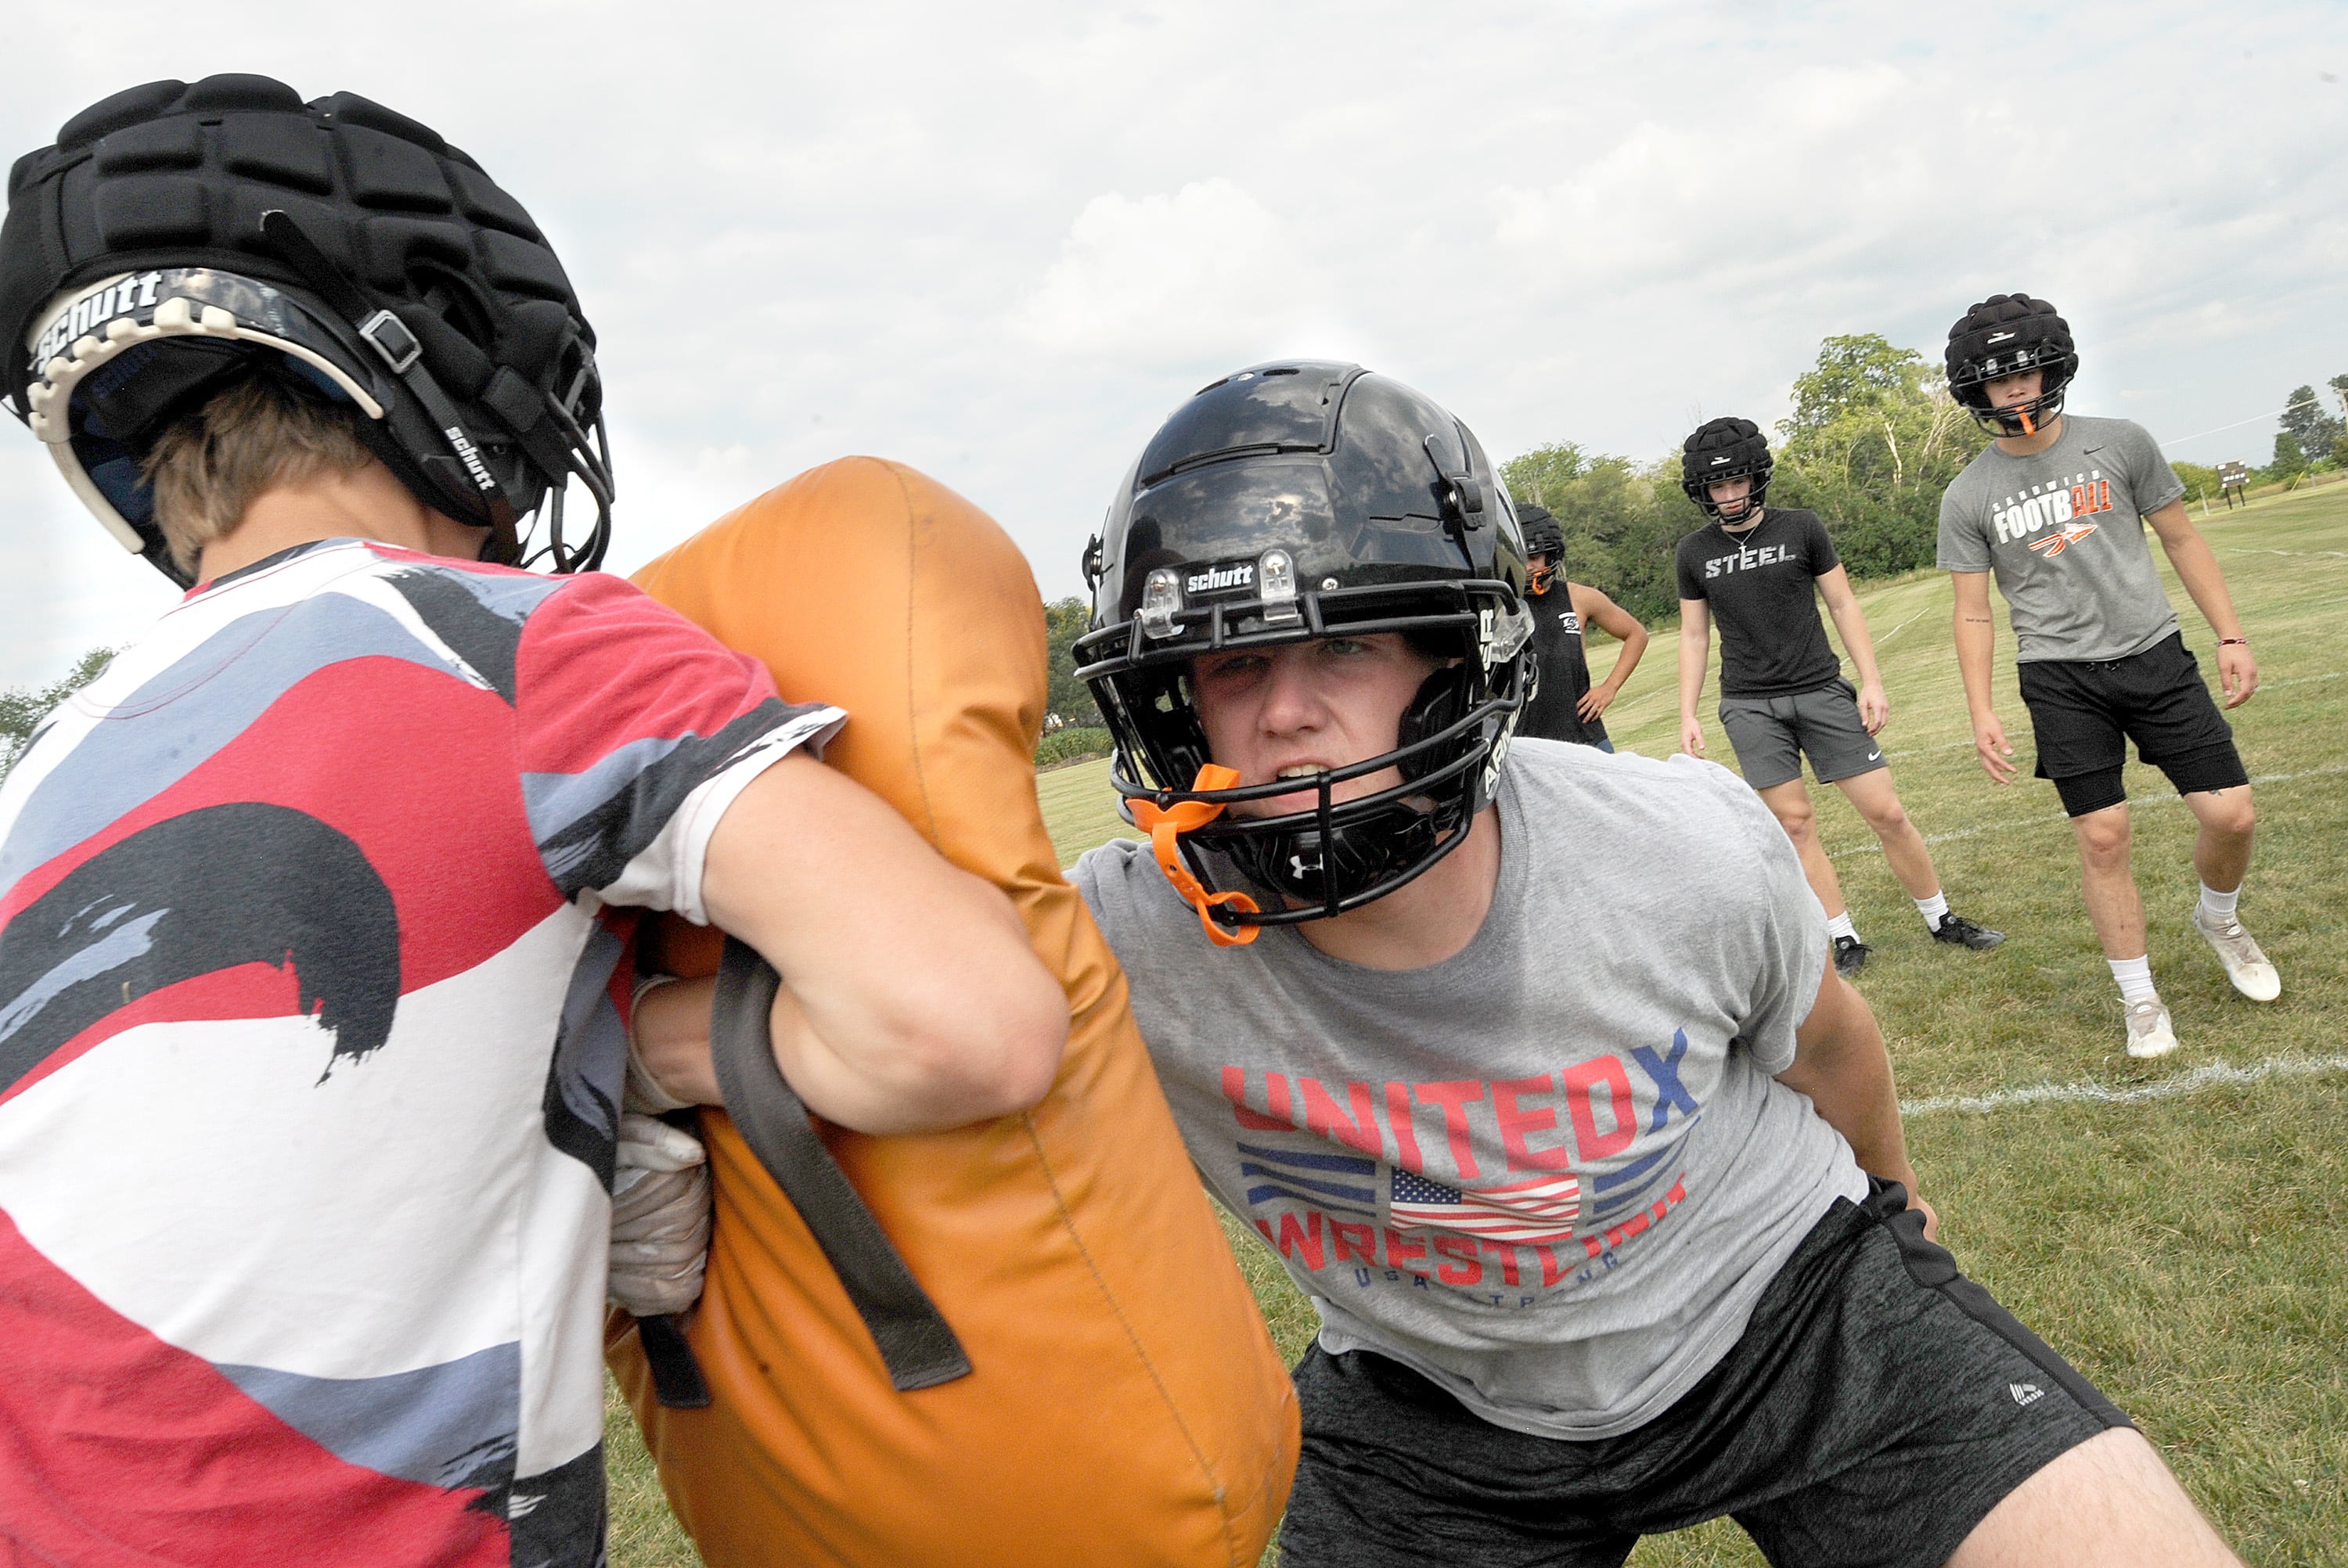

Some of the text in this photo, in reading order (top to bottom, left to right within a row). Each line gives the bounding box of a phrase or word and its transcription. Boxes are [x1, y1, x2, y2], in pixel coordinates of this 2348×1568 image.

[28, 271, 162, 376] schutt
[445, 426, 496, 491] schutt
[1993, 479, 2113, 545] FOOTBALL
[1187, 564, 1254, 592] schutt
[1705, 544, 1795, 579] STEEL
